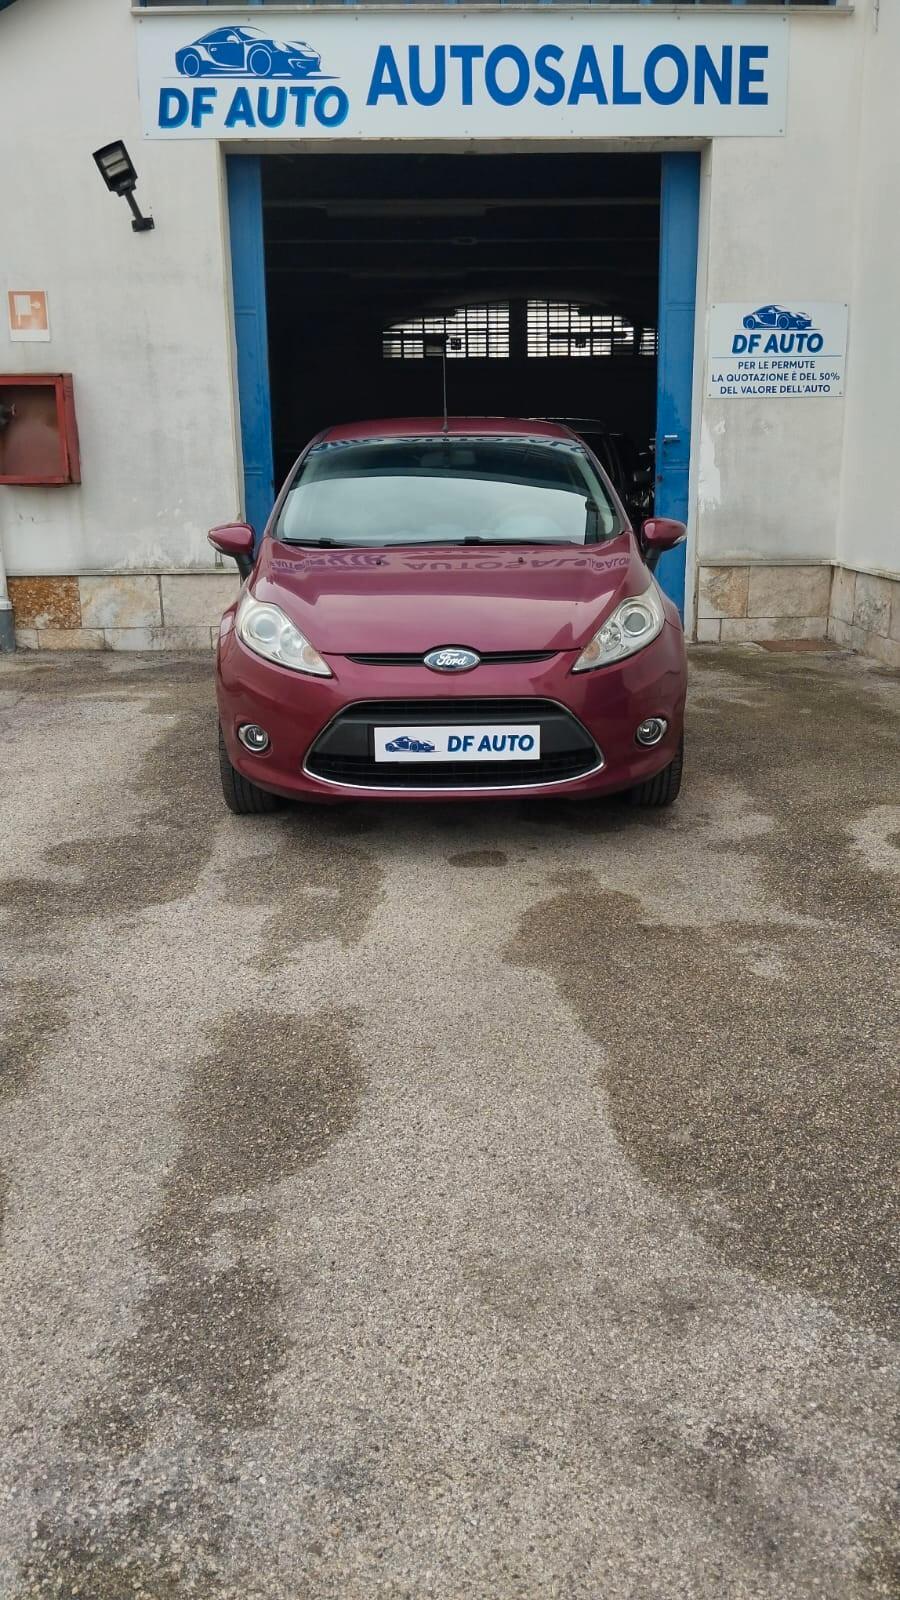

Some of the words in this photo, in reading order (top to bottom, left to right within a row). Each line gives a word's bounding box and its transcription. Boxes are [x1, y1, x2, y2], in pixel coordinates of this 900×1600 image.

[366, 44, 769, 106] AUTOSALONE
[157, 86, 217, 128] DF
[223, 86, 350, 128] AUTO
[732, 334, 761, 354] DF
[764, 333, 824, 354] AUTO
[738, 361, 755, 370] PER
[758, 361, 769, 370] LE
[771, 360, 816, 370] PERMUTE
[711, 374, 724, 383] LA
[726, 372, 789, 383] QUOTAZIONE
[799, 372, 818, 382] DEL
[819, 371, 841, 381] 50%
[720, 385, 738, 395] DEL
[740, 385, 778, 395] VALORE
[779, 384, 831, 394] DELL'AUTO
[436, 651, 467, 667] Ford
[447, 735, 475, 752] DF
[478, 734, 535, 752] AUTO
